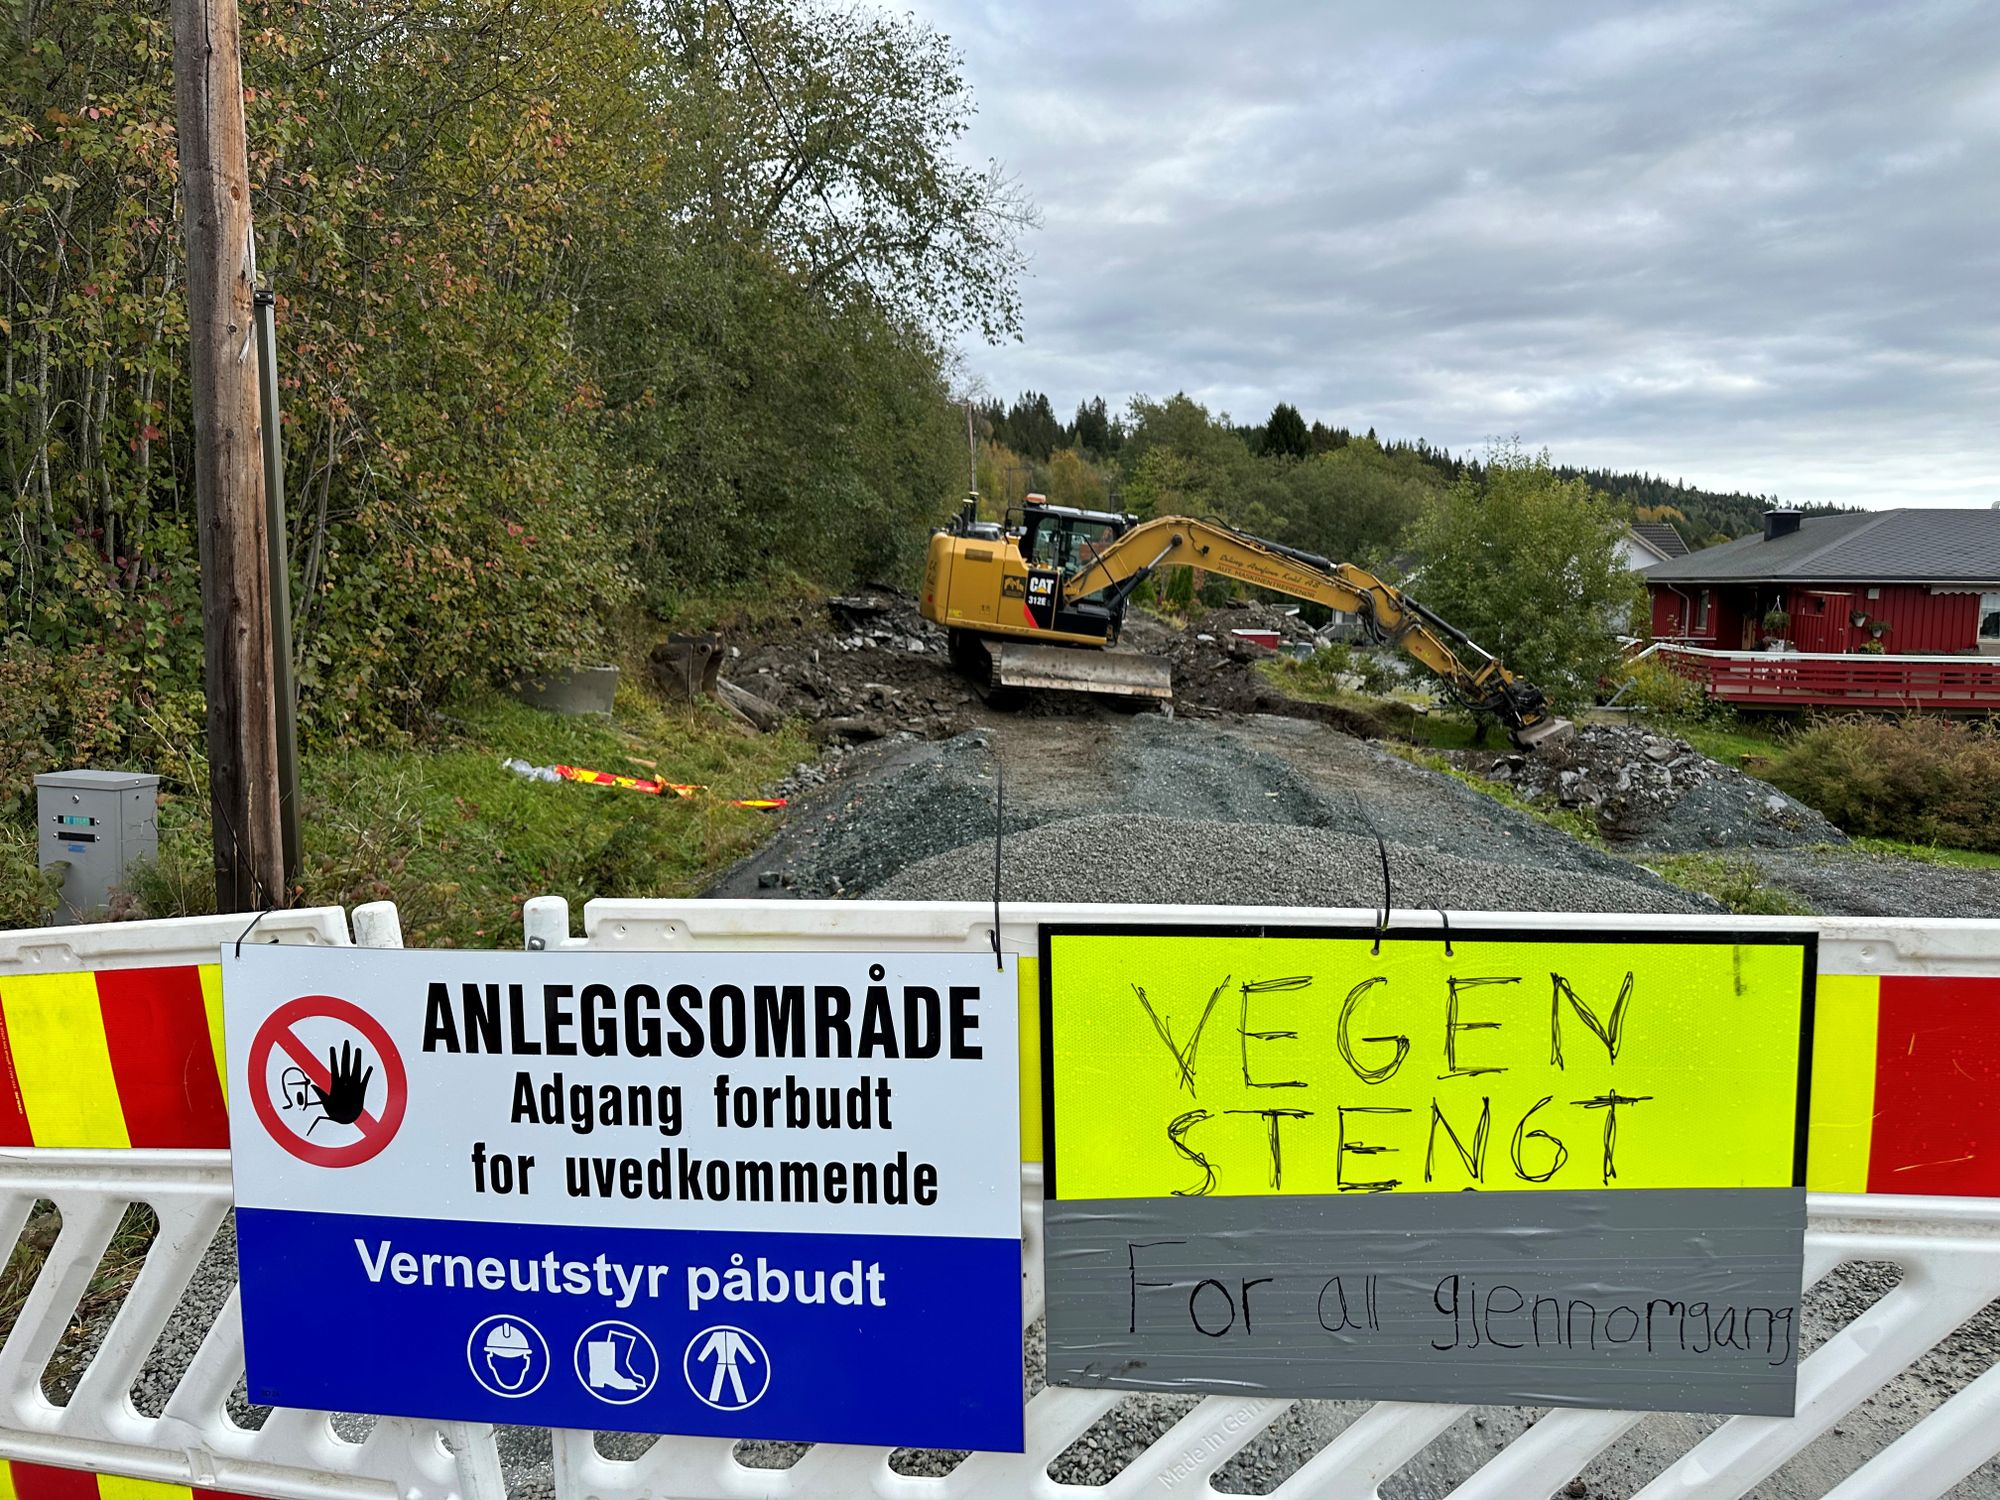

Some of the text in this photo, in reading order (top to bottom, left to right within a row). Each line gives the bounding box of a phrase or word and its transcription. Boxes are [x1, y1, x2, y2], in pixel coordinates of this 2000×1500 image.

[1028, 595, 1047, 607] 312E
[1029, 576, 1055, 595] CAT
[422, 963, 983, 1060] ANLEGGSOMRÅDE
[1131, 971, 1634, 1100] VEGEN
[510, 1071, 893, 1137] Adgang forbudt
[471, 1142, 939, 1207] for uvedkommende
[1167, 1088, 1654, 1197] STENGT
[353, 1238, 886, 1311] Verneutstyr påbudt
[1127, 1241, 1794, 1367] For all gjennomgang
[1157, 1447, 1209, 1491] Made
[1199, 1430, 1226, 1453] in
